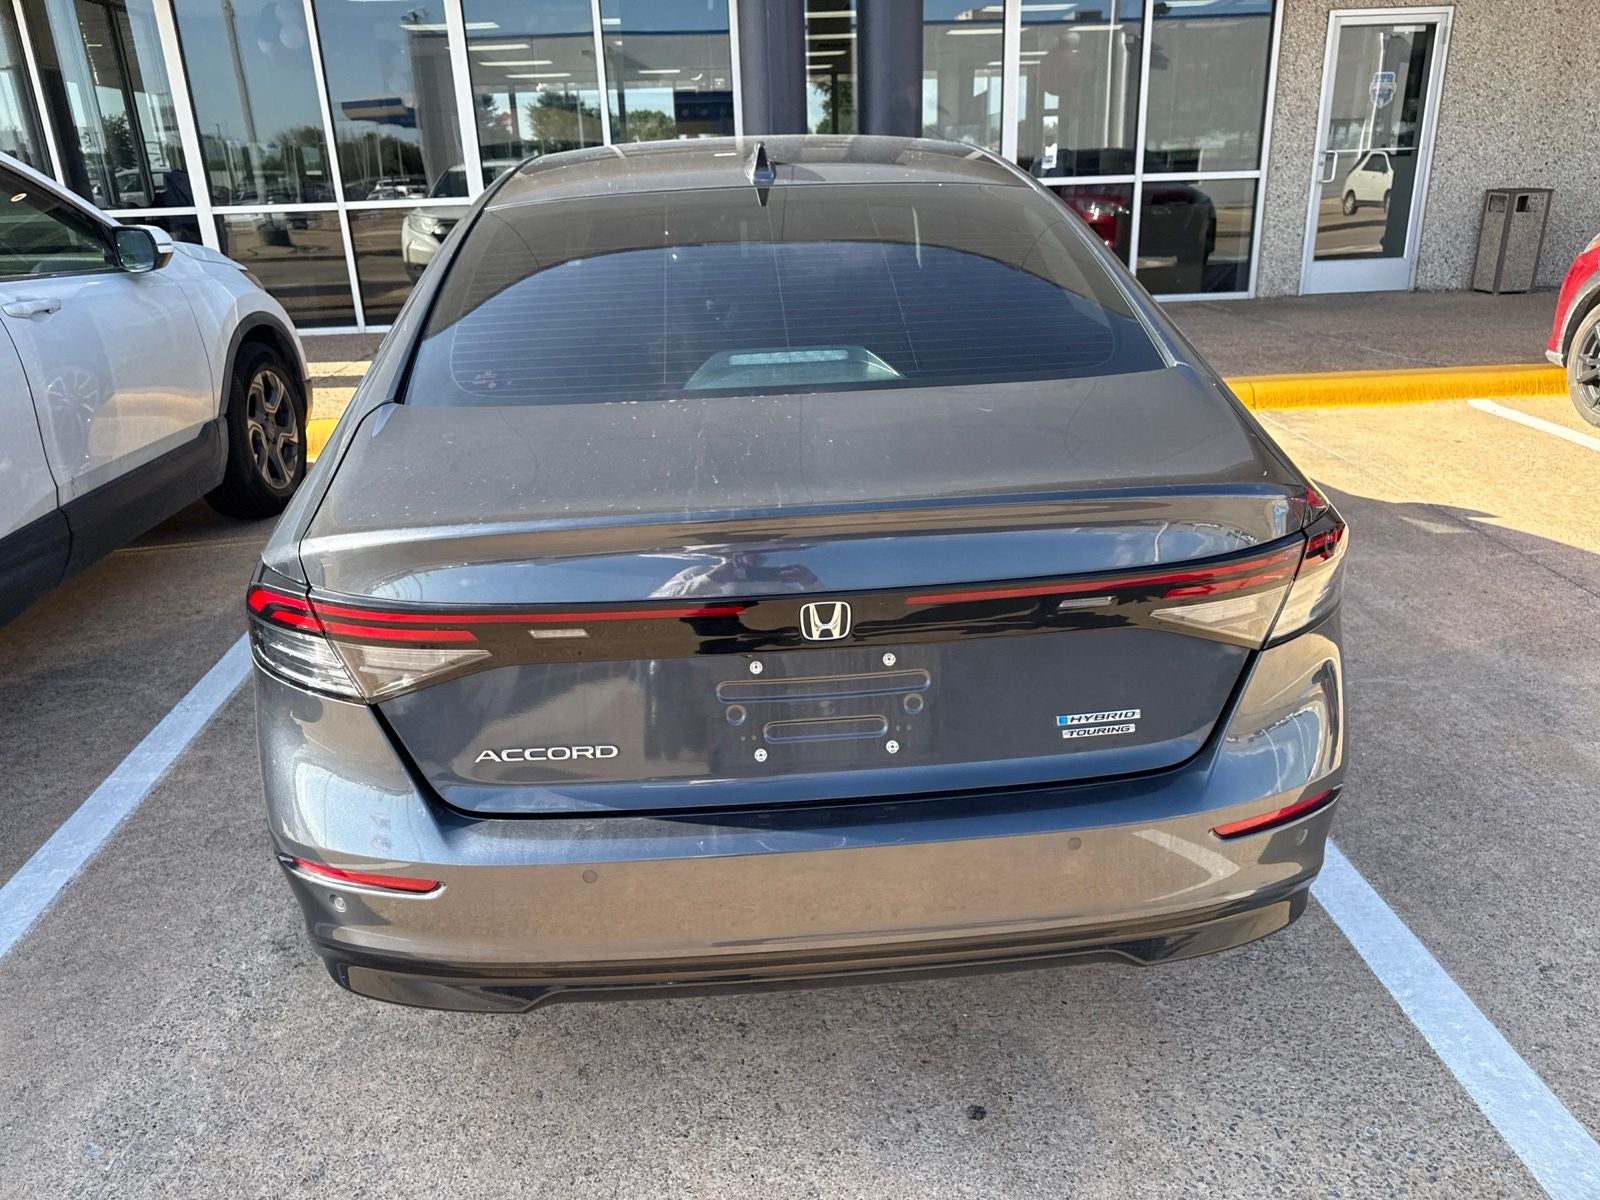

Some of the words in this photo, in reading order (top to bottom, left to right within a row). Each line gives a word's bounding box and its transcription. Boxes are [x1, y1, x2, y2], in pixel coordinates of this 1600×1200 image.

[1070, 711, 1136, 723] HYBRID
[1067, 725, 1131, 737] TOURING
[475, 745, 619, 763] ACCORD
